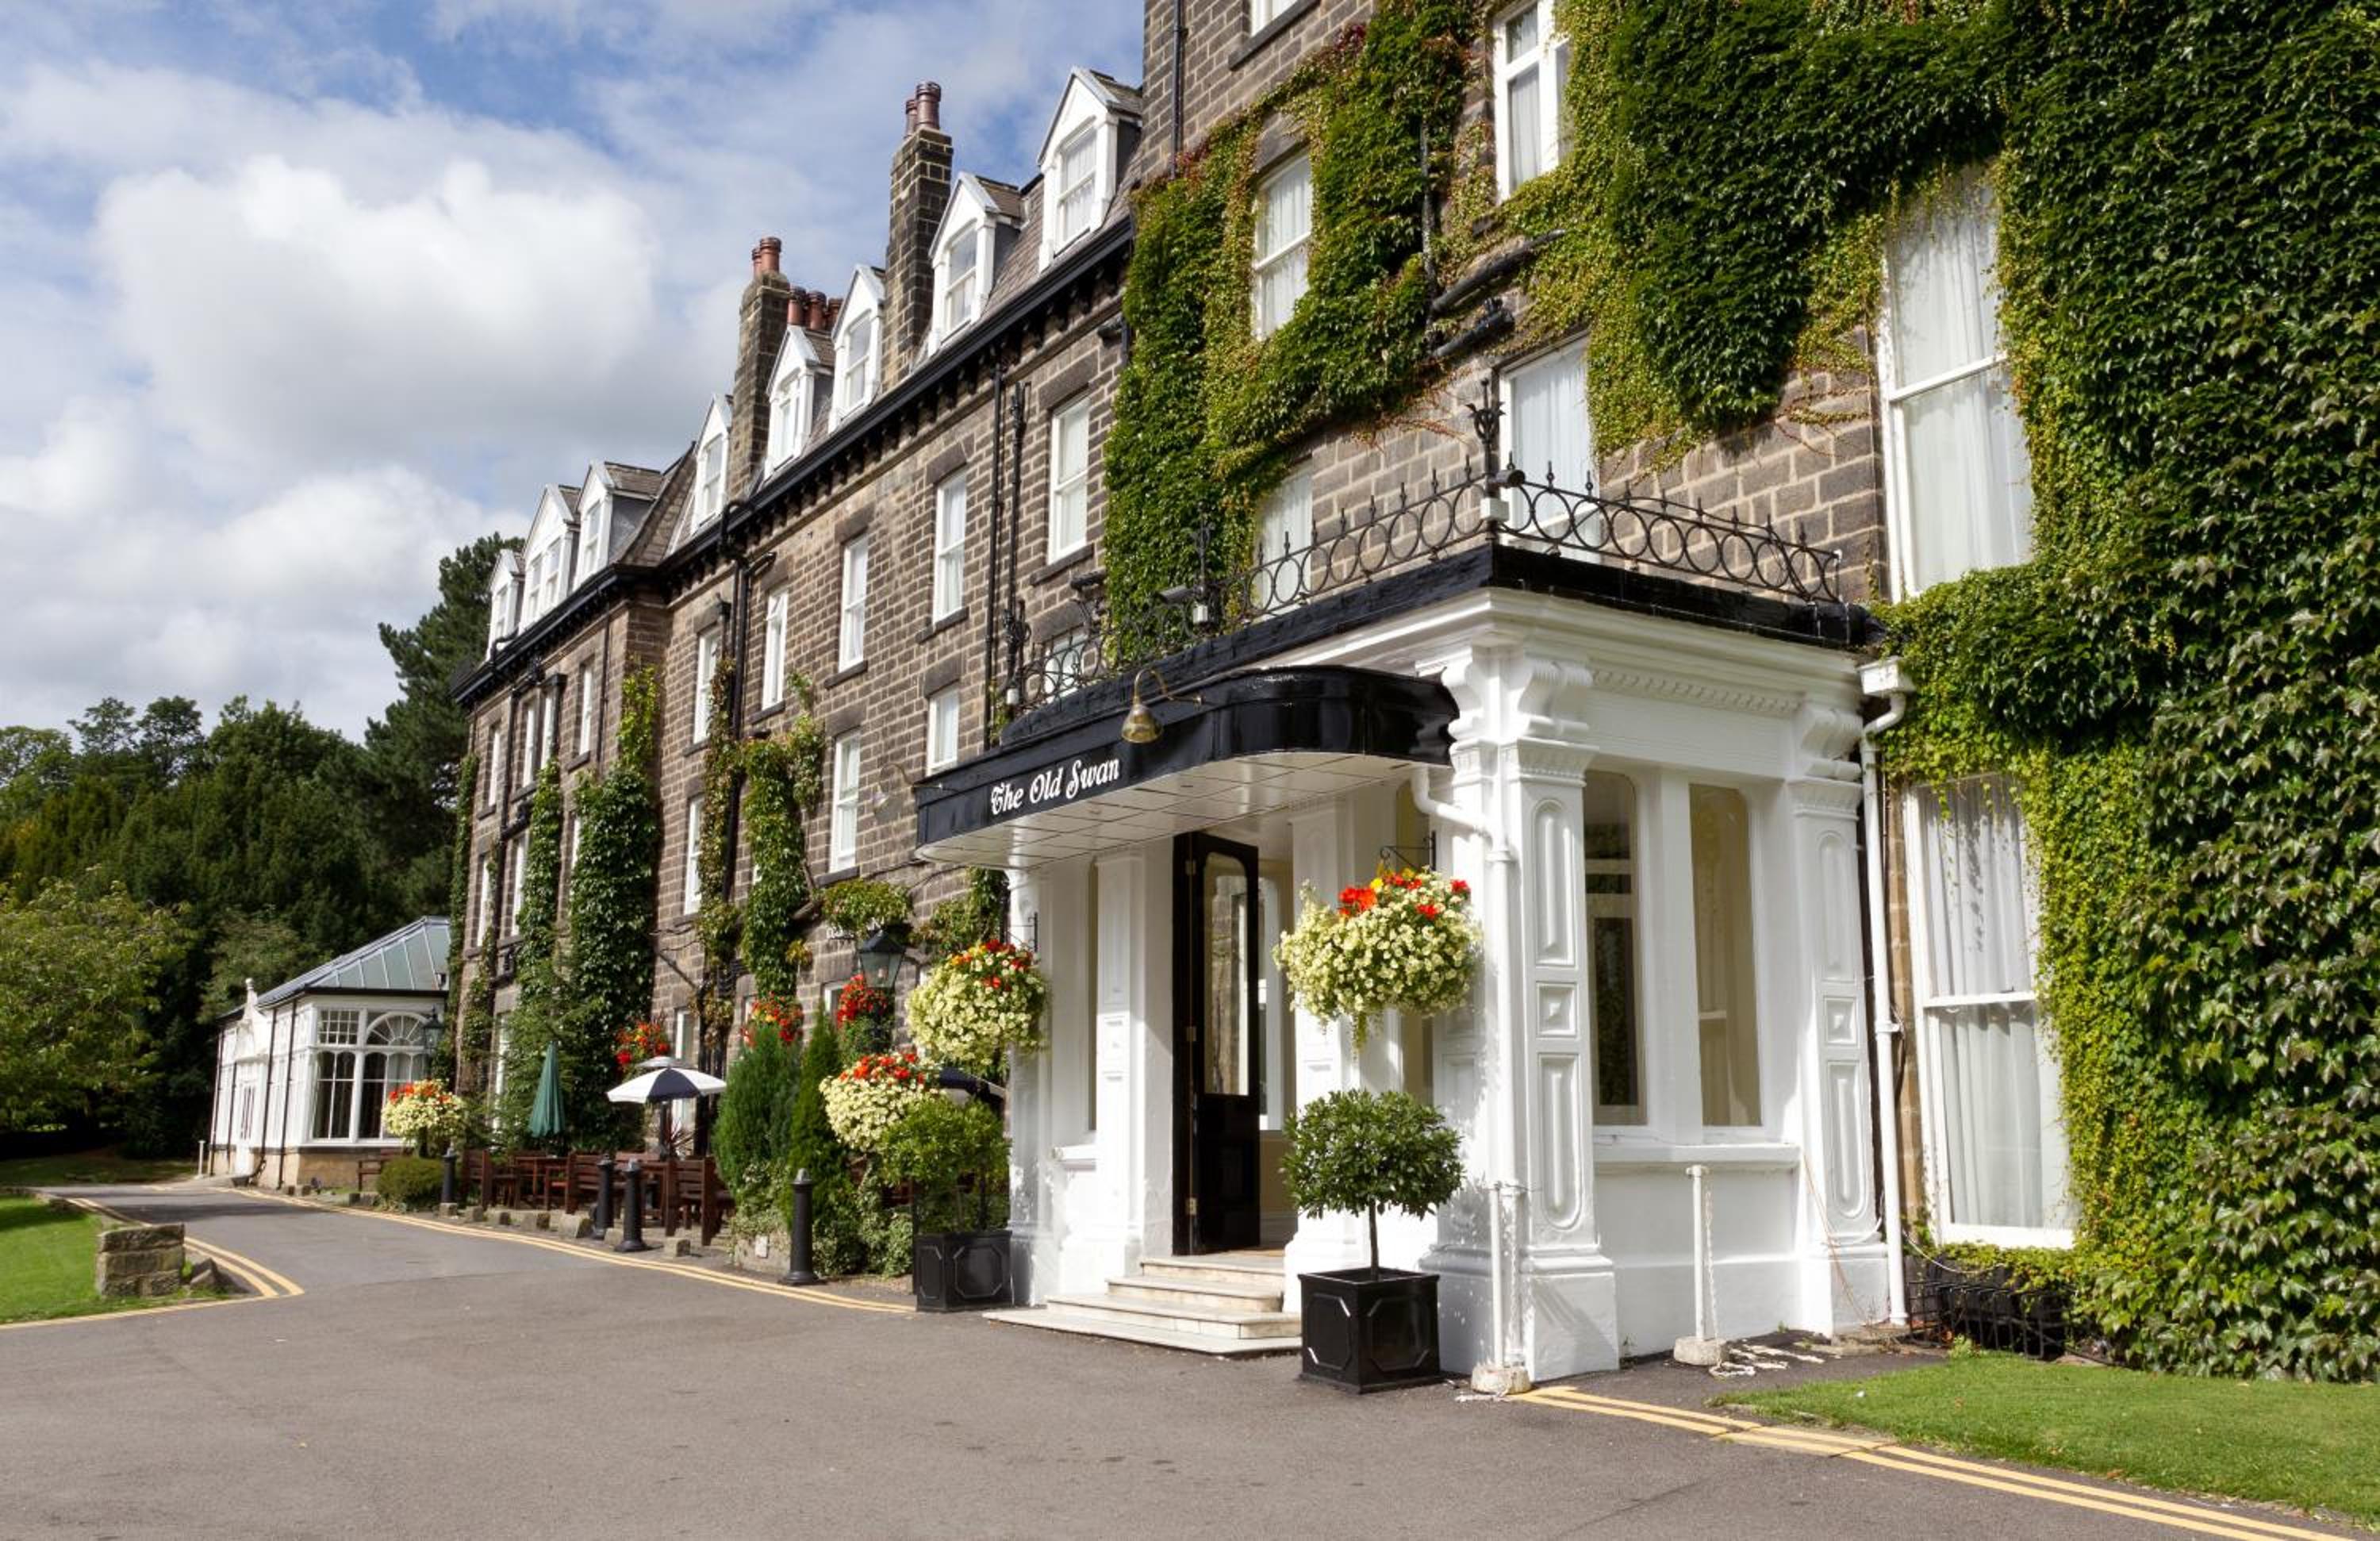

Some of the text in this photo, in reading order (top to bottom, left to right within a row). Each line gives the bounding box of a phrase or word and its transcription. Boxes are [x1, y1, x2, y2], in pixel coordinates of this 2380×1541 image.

[991, 759, 1119, 815] The Old Swan
